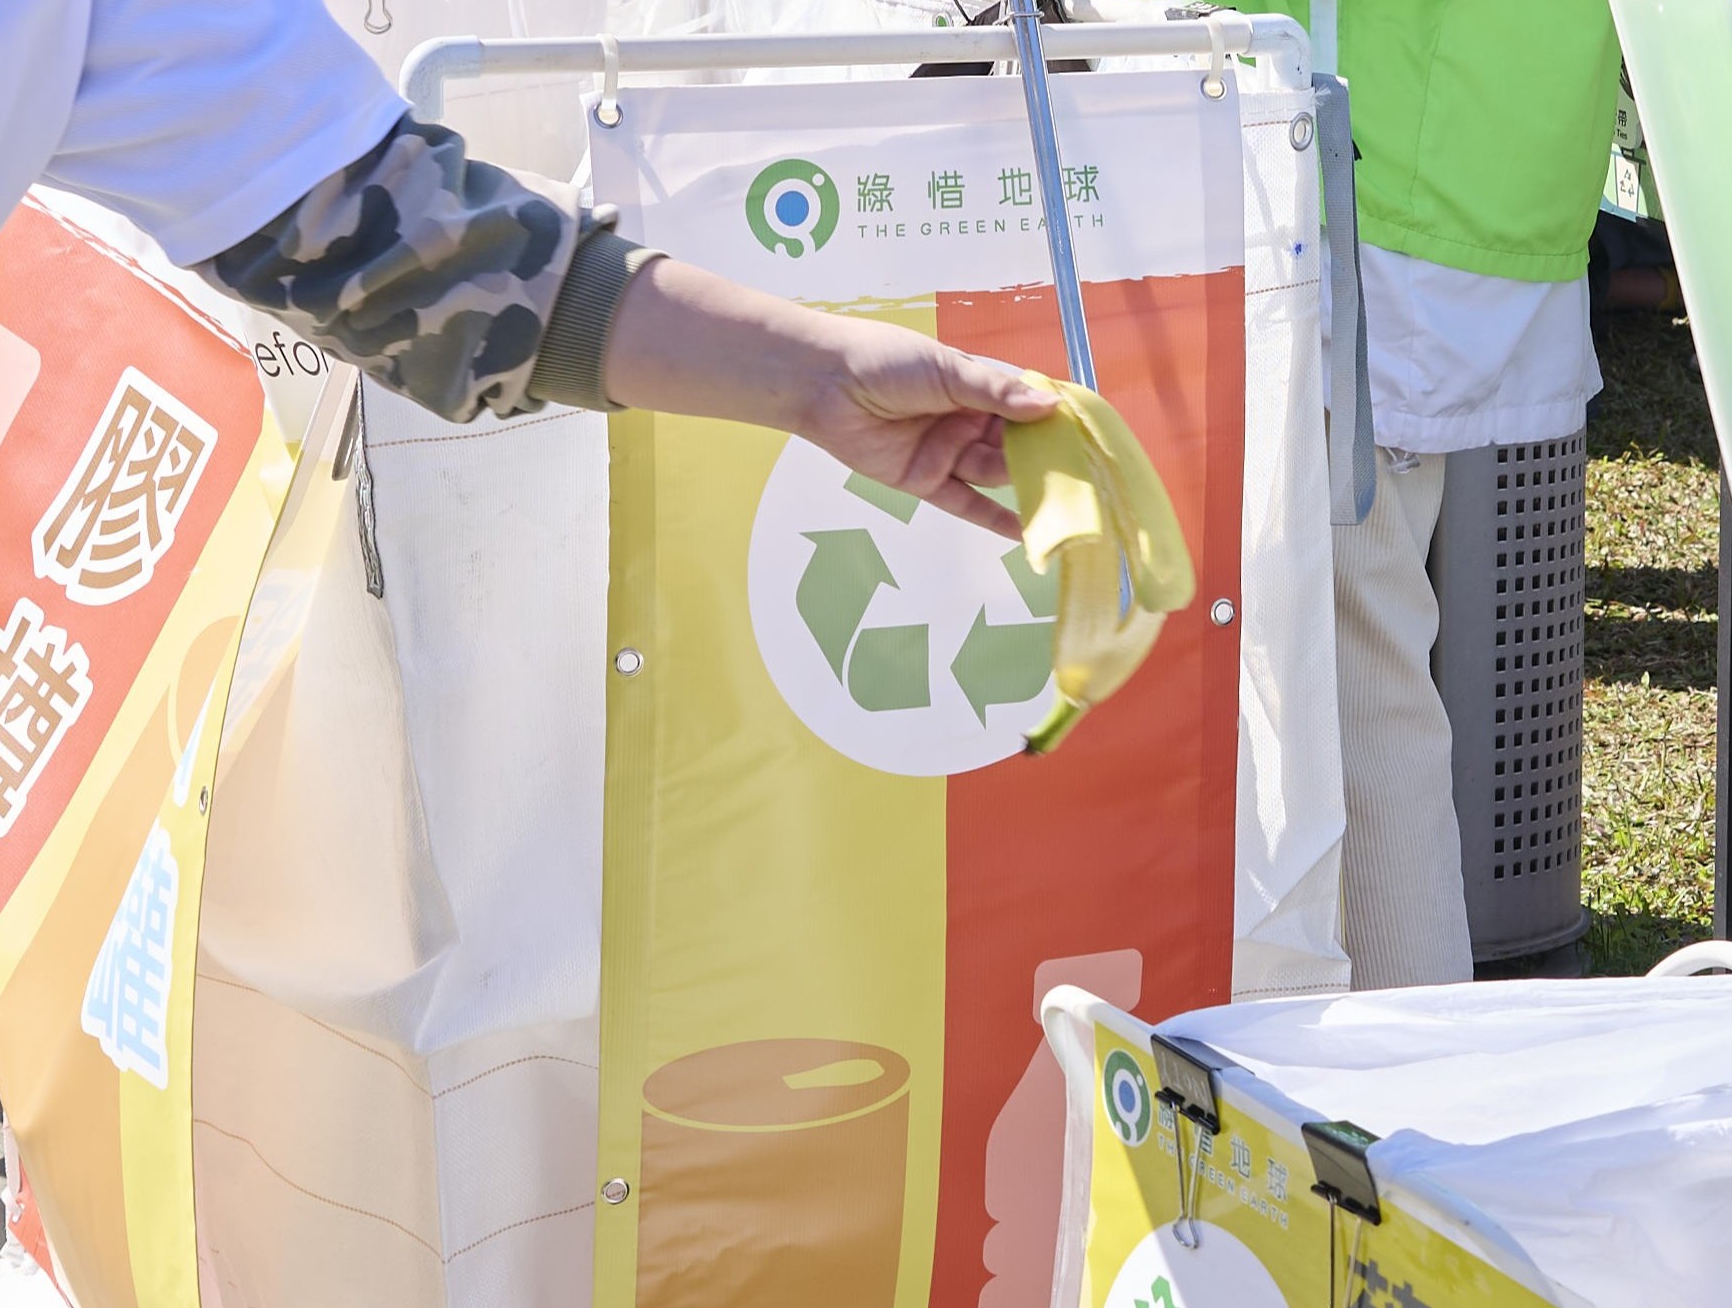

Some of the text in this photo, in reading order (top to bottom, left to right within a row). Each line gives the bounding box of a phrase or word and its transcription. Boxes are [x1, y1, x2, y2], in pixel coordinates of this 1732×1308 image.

[857, 164, 1100, 213] 綠惜地球
[857, 213, 1106, 239] THE GREEN EATH
[1240, 1185, 1289, 1230] EARTH
